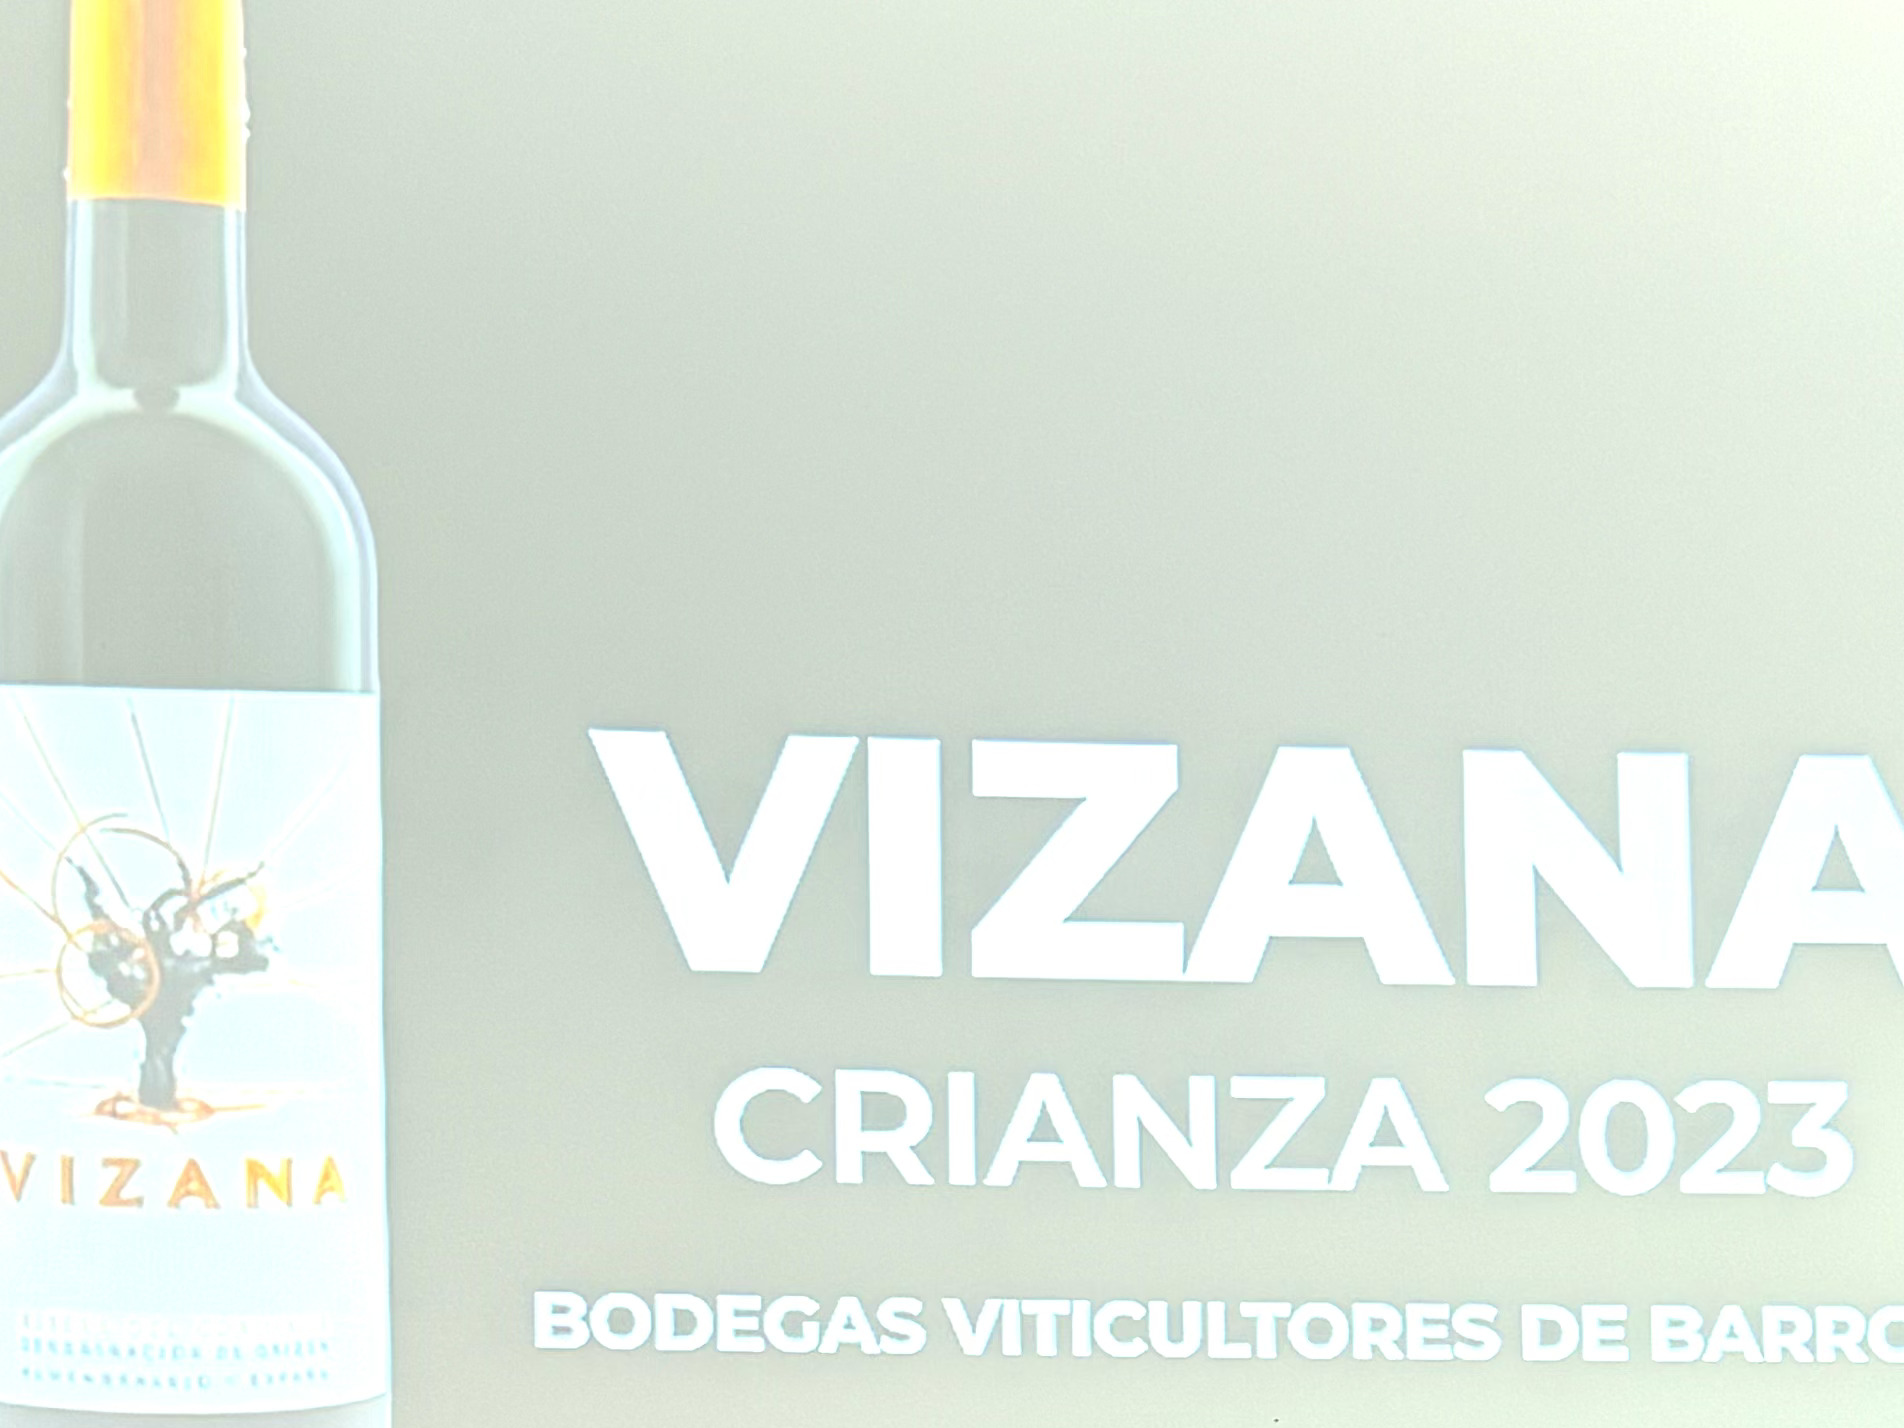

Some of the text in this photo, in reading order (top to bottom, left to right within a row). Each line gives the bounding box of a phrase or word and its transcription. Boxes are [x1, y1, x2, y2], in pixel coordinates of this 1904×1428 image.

[713, 1067, 1854, 1199] CRIANZA 2023
[0, 1151, 348, 1208] VIZANA
[533, 1290, 927, 1356] BODEGAS
[940, 1296, 1503, 1362] VITICULTORES
[1520, 1303, 1630, 1363] DE
